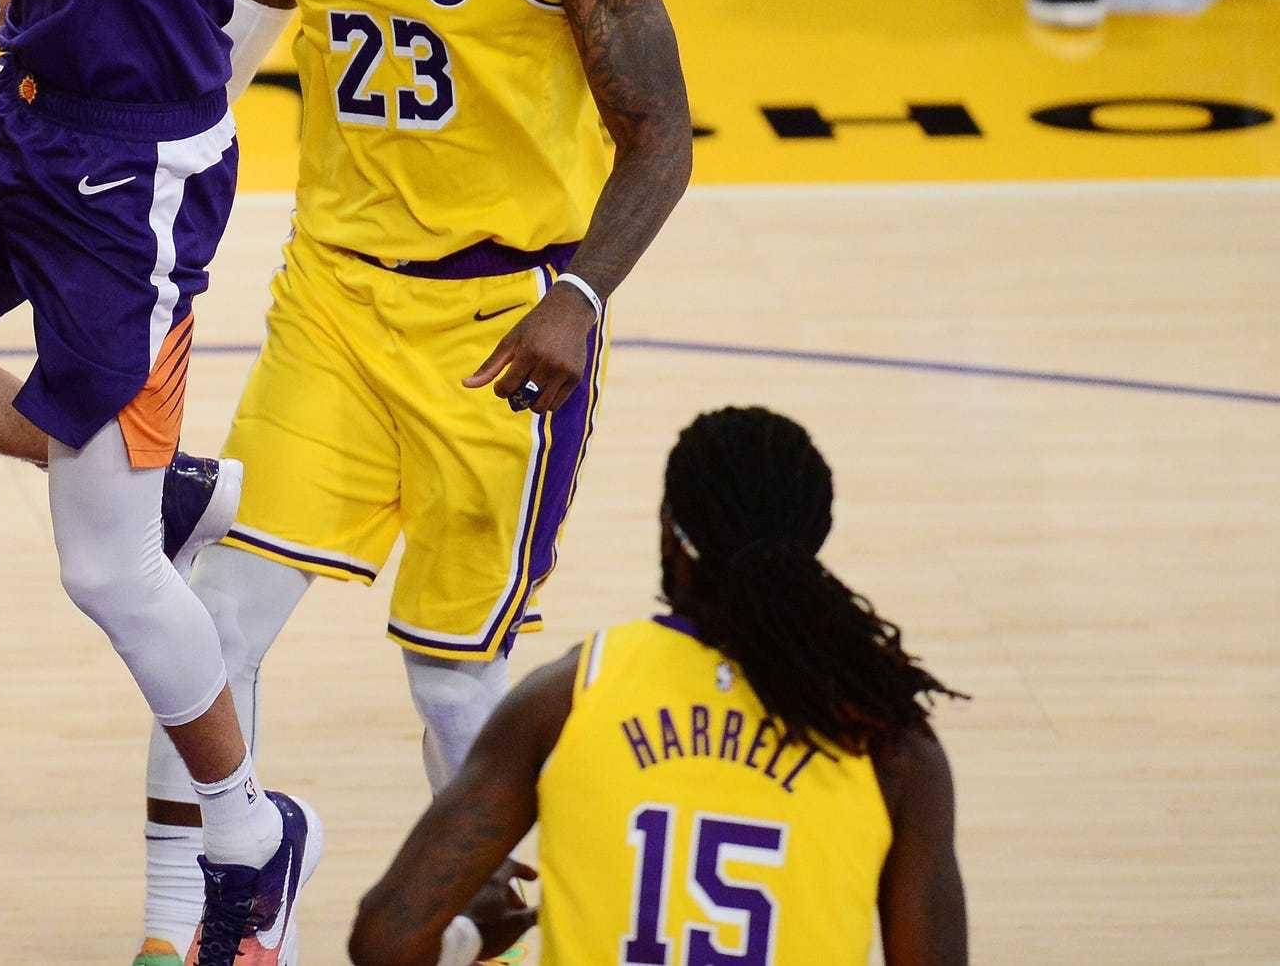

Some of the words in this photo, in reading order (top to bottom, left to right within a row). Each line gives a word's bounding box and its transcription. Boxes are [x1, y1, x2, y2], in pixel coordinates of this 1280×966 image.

[329, 10, 457, 131] 23
[621, 705, 816, 793] HARRELL
[619, 801, 790, 966] 15
